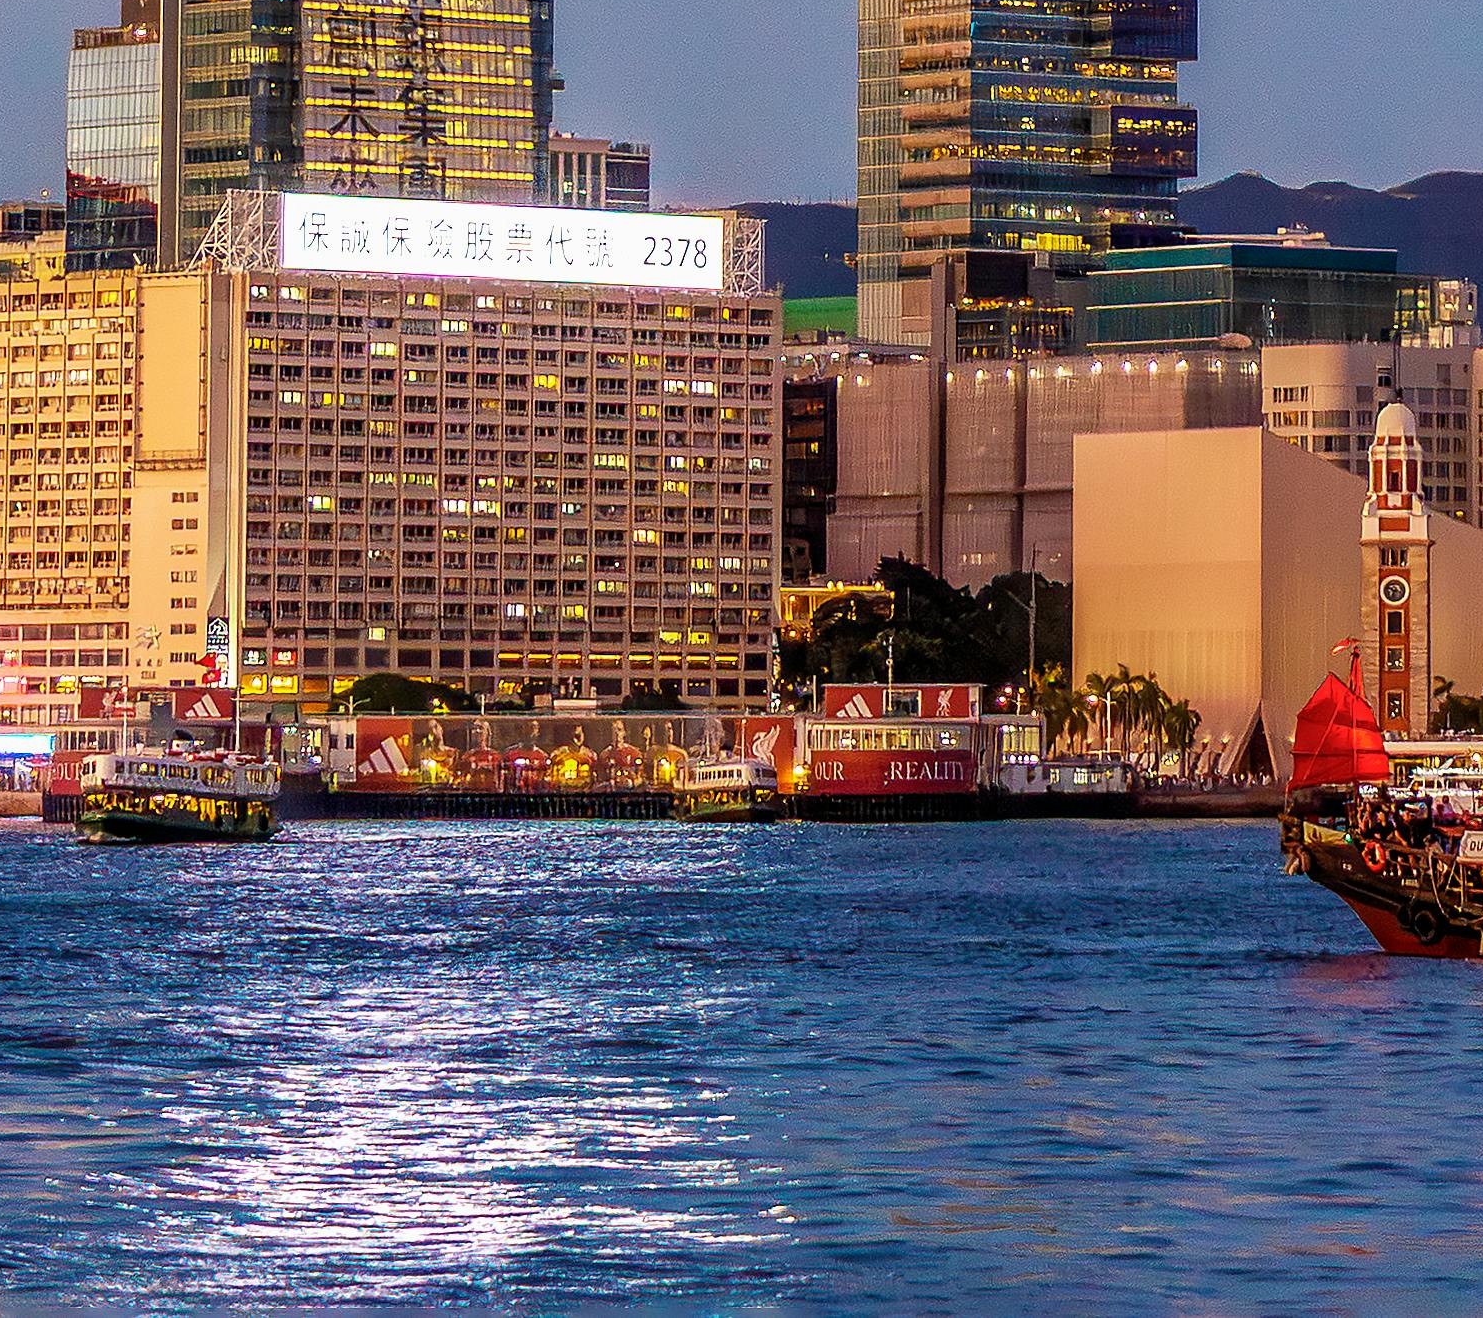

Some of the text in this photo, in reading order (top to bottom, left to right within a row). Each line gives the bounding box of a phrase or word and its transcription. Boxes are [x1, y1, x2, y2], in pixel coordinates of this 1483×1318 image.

[300, 211, 707, 268] 保誠保險股票代號 2378
[815, 761, 844, 780] OUR
